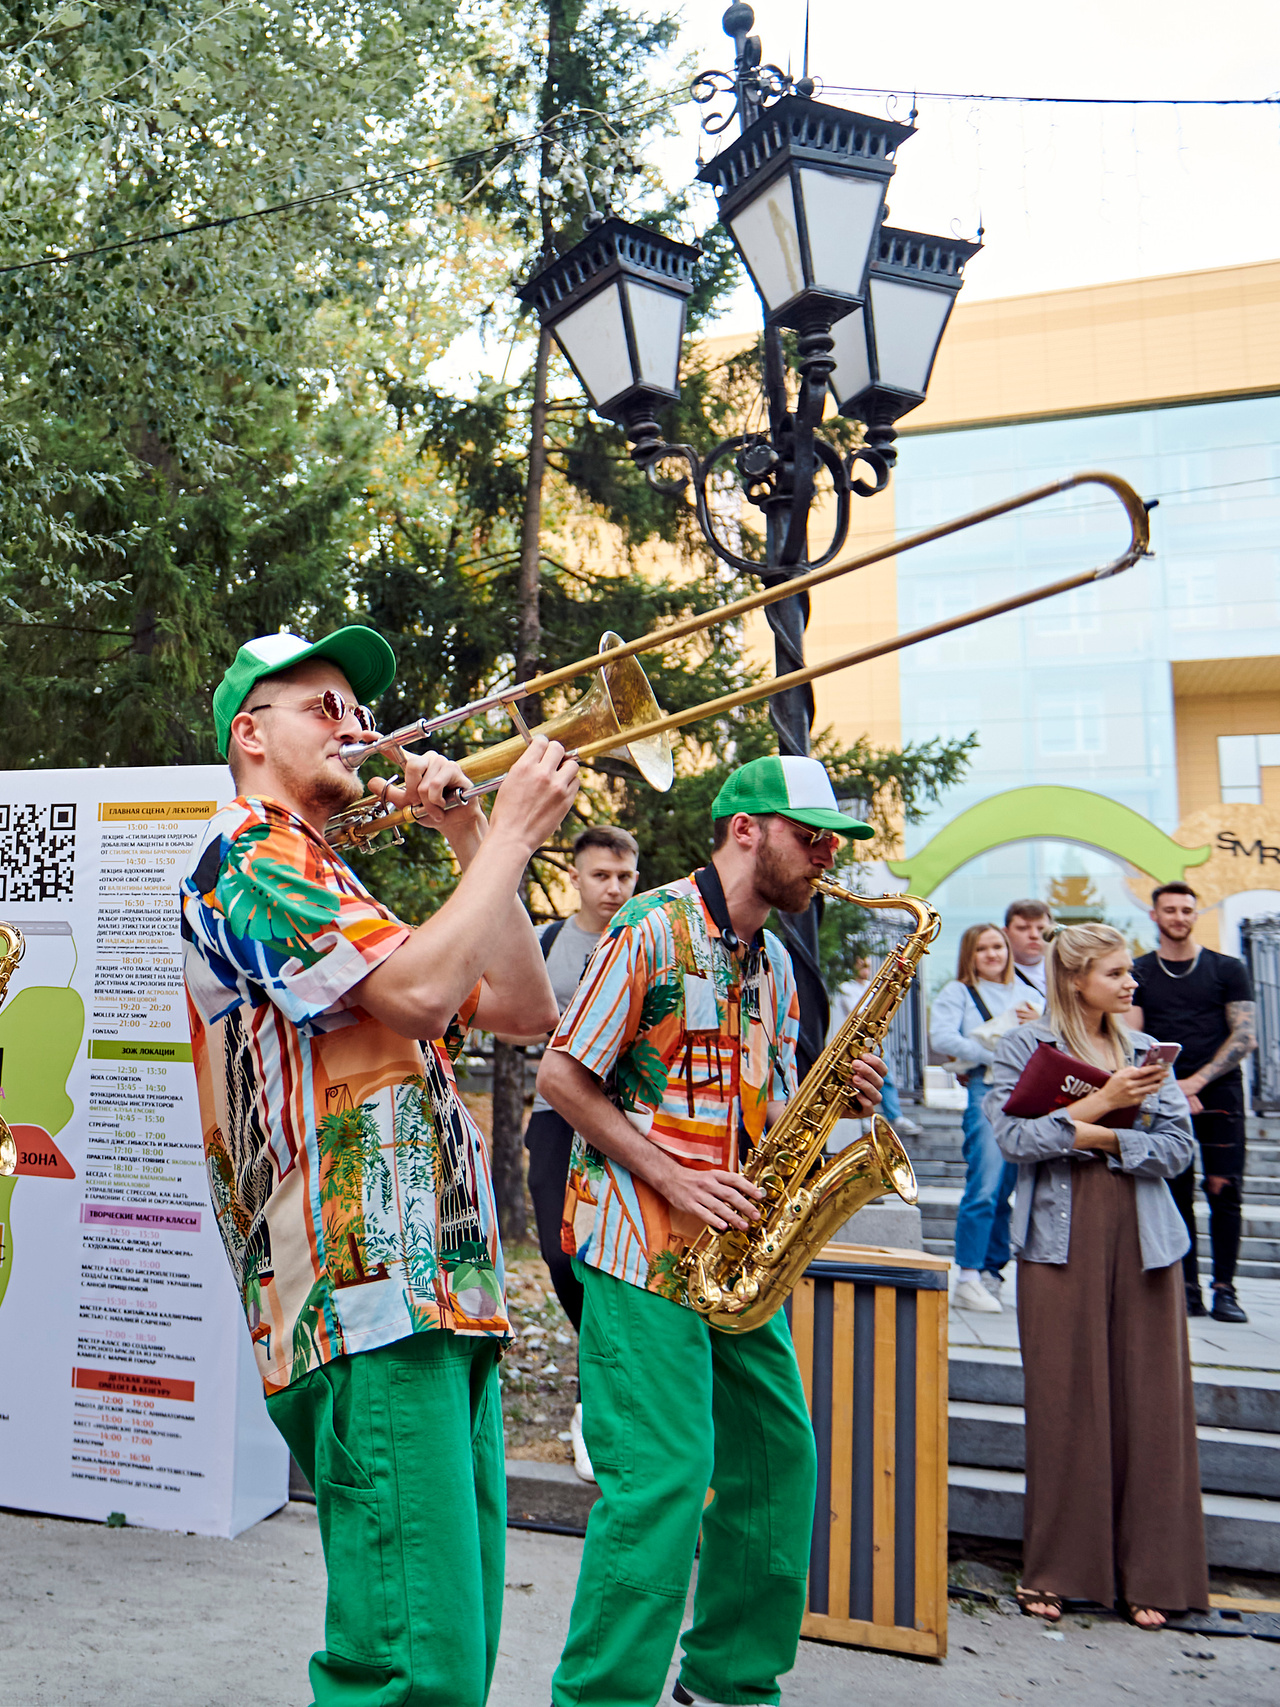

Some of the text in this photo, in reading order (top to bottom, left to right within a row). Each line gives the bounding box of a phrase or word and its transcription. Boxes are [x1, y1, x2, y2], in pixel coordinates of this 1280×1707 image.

[172, 806, 210, 814] ЛЕКТОРИЙ
[156, 857, 175, 865] 15:30
[140, 1048, 174, 1056] ЛОКАЦИИ
[118, 1066, 167, 1075] 12:30 13:30
[146, 1084, 166, 1092] 14:30
[145, 1115, 164, 1123] 15:30
[114, 1130, 166, 1140] 16:00 17:00
[114, 1146, 163, 1156] 17:10 18:00
[20, 1151, 57, 1166] ЗОНА
[142, 1165, 163, 1174] 19:00
[90, 1210, 197, 1225] ТВОРЧЕСКИЕ МАСТЕР-КЛАССЫ
[102, 1395, 154, 1408] 12:00 19:00
[132, 1436, 152, 1445] 17:00
[99, 1466, 120, 1476] 19:00
